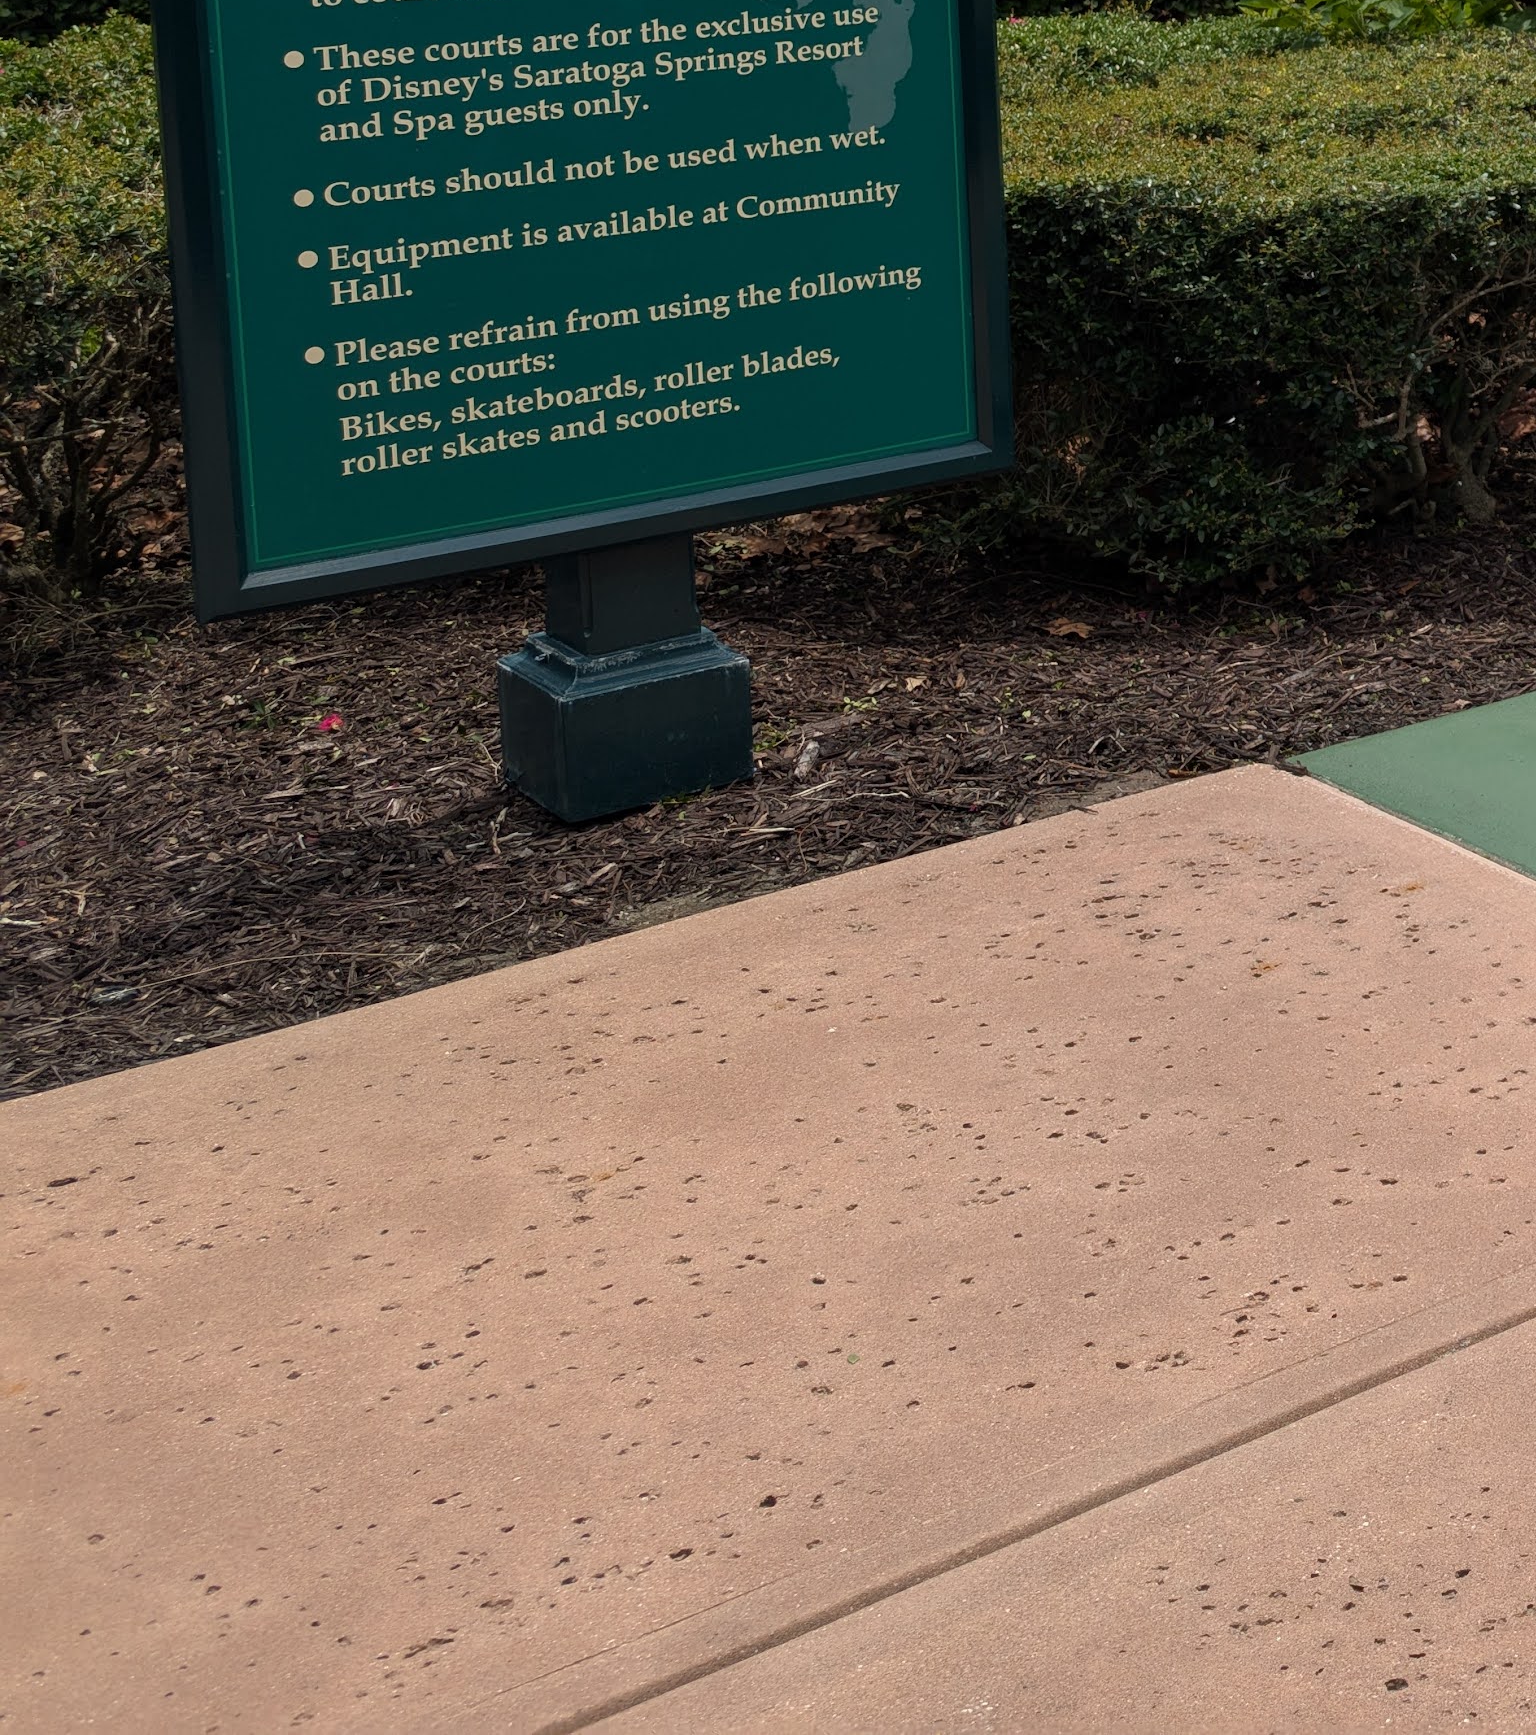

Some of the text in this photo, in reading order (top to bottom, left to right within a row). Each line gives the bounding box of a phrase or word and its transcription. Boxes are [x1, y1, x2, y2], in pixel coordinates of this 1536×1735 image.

[312, 6, 880, 71] These courts are for the exclusive use
[316, 37, 863, 108] of Disney's Saratoga Springs Resort
[318, 89, 650, 142] and Spa guests only.
[322, 125, 885, 206] Courts should not be used when wet.
[328, 181, 900, 275] Equipment is available at Community
[330, 273, 413, 306] Hall.
[334, 265, 922, 367] Please refrain from using the following
[337, 353, 556, 401] on the courts:
[338, 346, 840, 443] Bikes, skateboards, roller blades,
[341, 389, 741, 477] roller skates and scooters.
